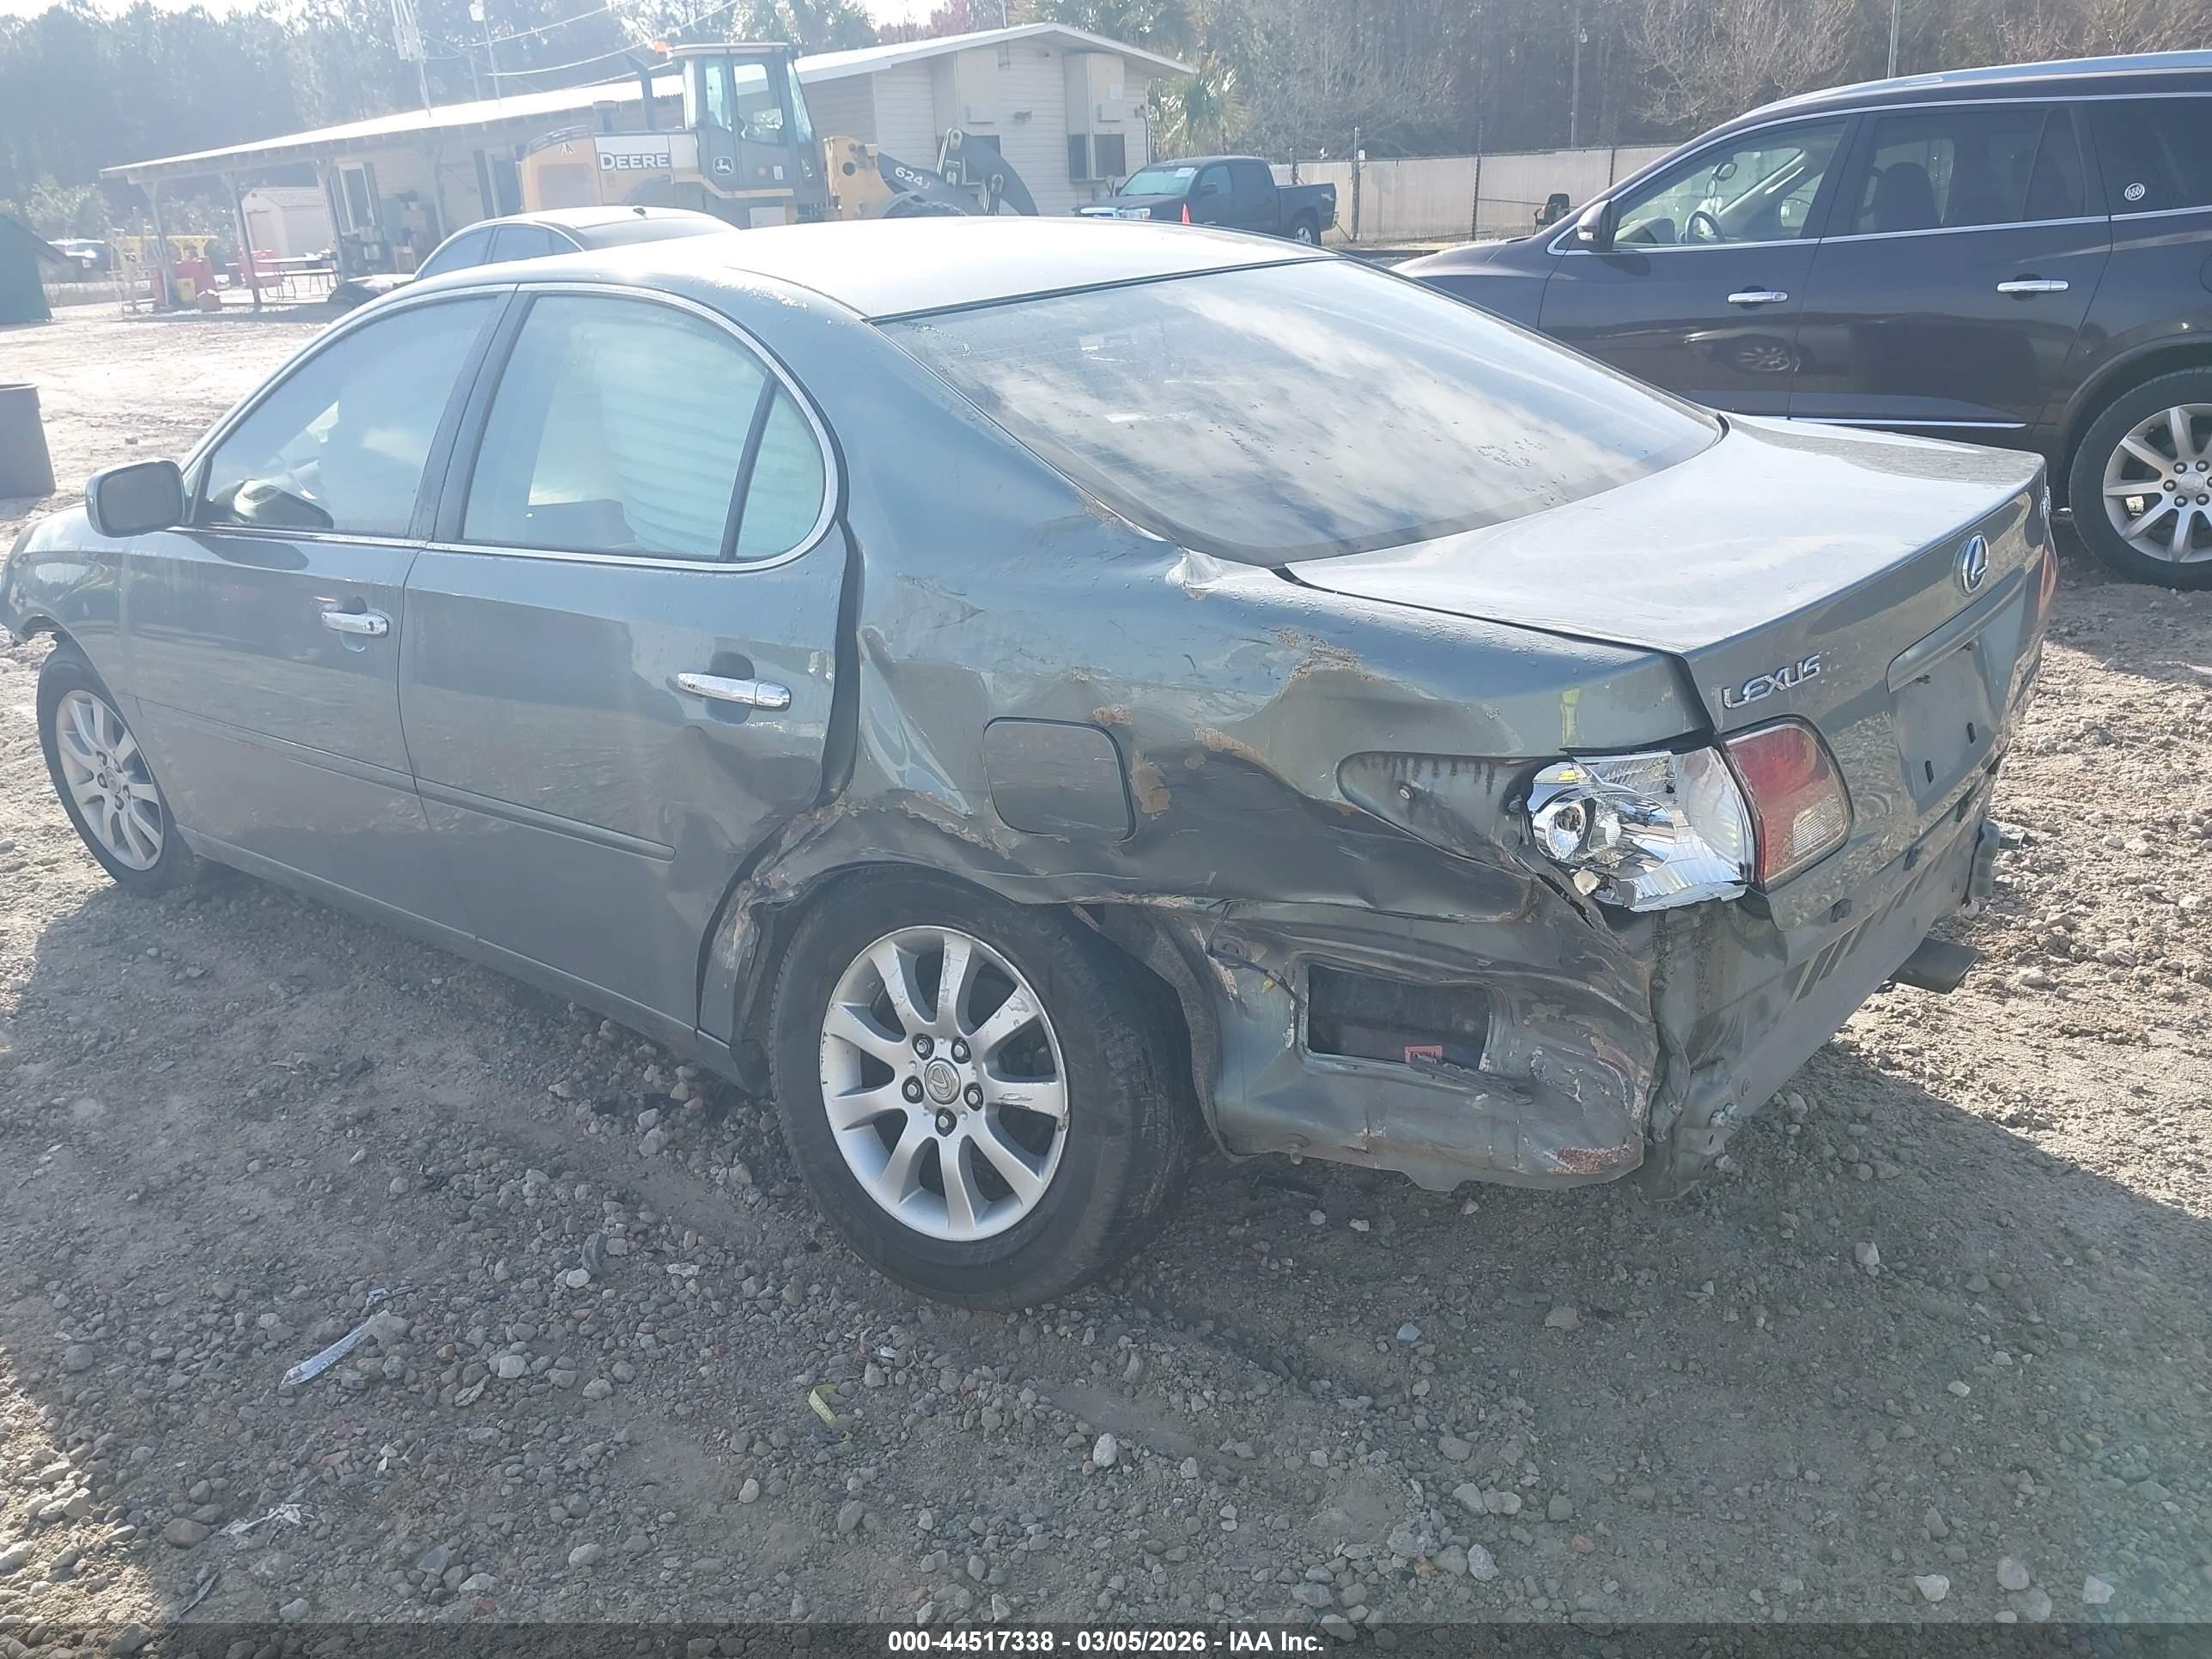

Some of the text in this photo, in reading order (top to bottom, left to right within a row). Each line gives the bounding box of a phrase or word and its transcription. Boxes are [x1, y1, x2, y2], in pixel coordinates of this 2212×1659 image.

[599, 152, 671, 171] DEERE
[895, 167, 931, 190] 624J
[1723, 654, 1821, 708] LEXUS
